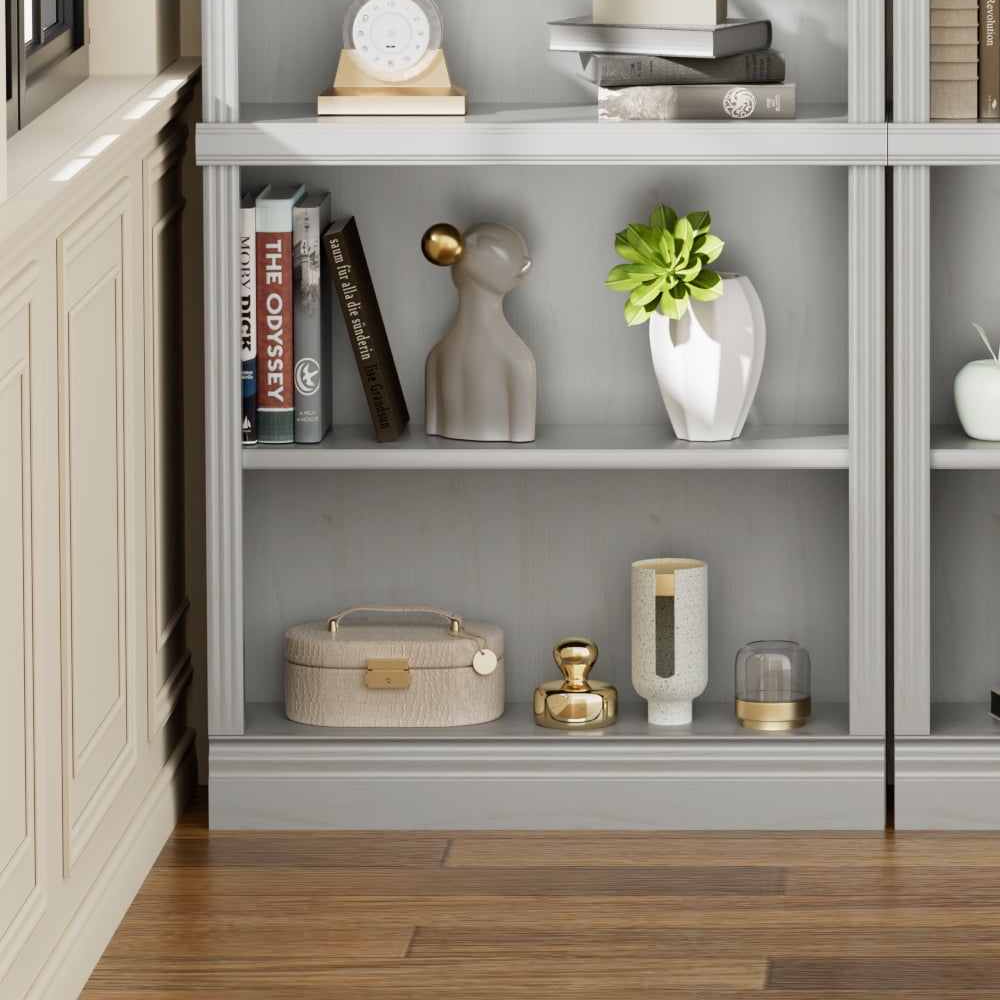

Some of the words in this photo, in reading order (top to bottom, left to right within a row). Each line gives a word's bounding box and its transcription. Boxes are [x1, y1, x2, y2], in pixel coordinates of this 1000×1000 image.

[266, 240, 282, 285] THE
[329, 238, 344, 264] saum
[336, 265, 352, 282] für
[341, 282, 358, 300] alla
[240, 296, 252, 352] DICK
[347, 300, 360, 317] die
[266, 293, 284, 403] ODYSSEY
[352, 317, 373, 361] sünderin
